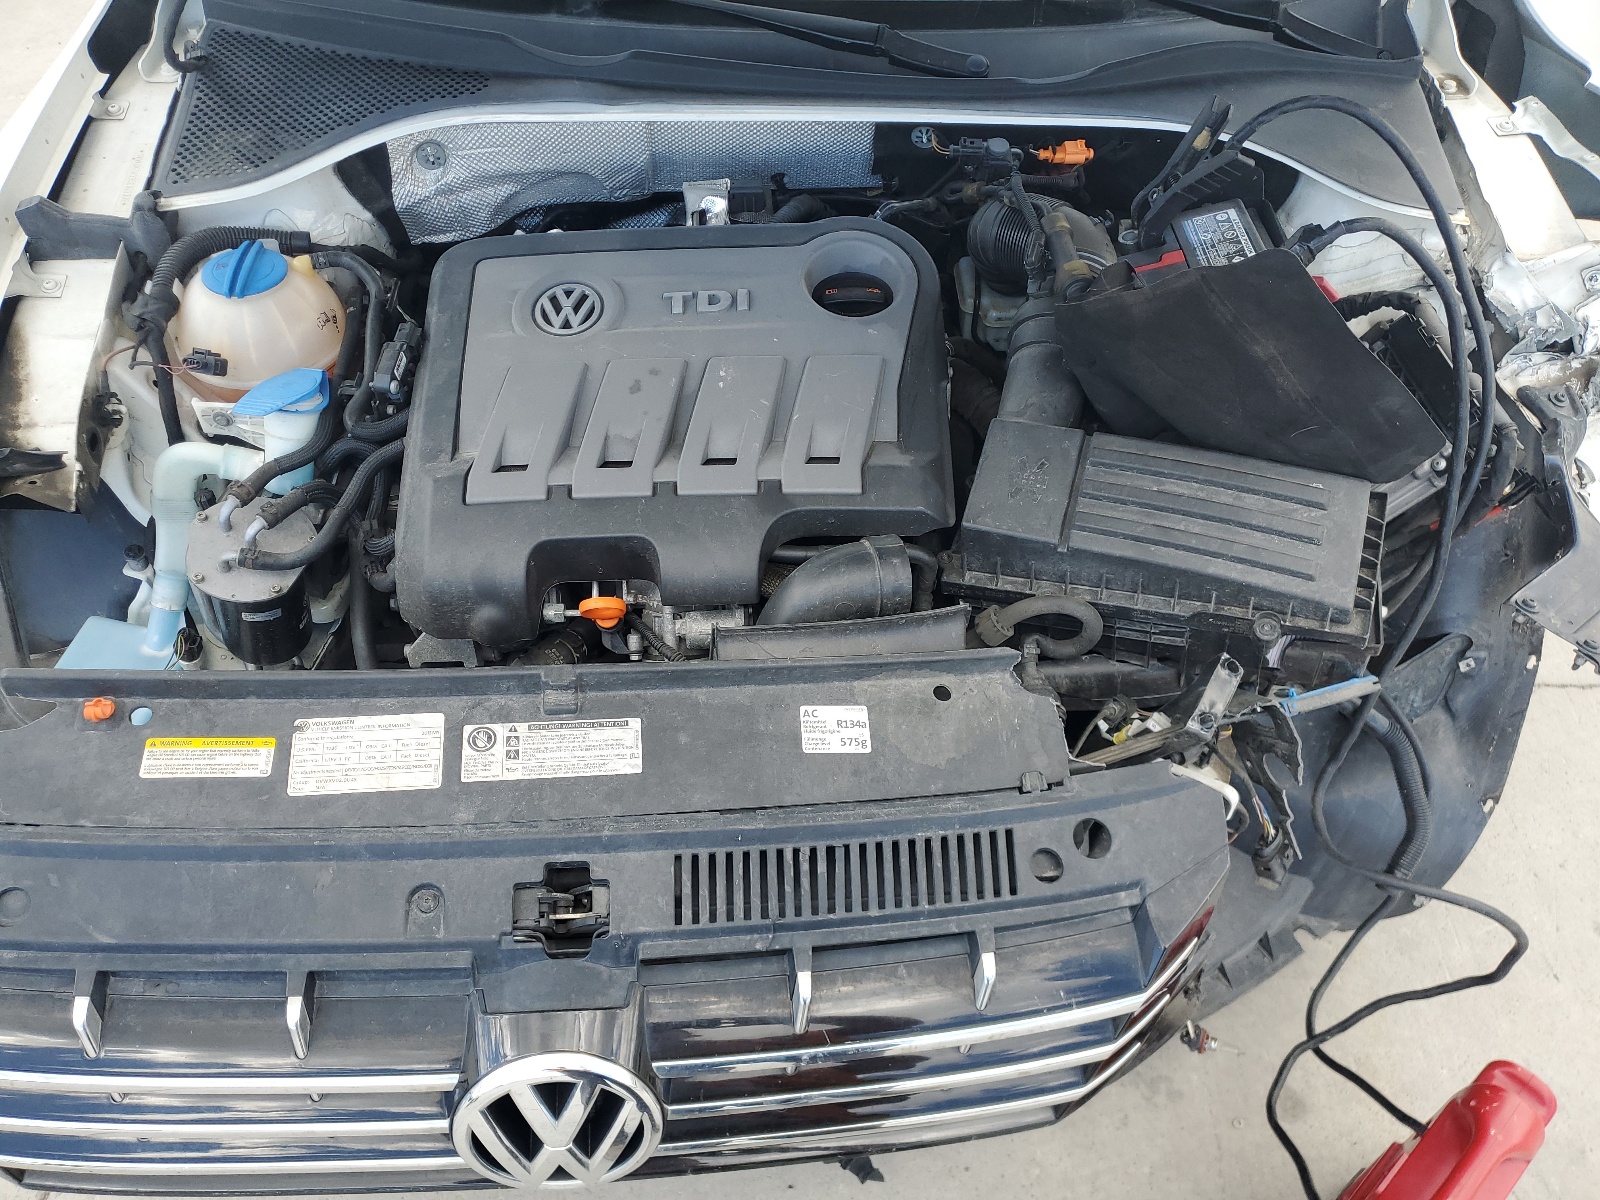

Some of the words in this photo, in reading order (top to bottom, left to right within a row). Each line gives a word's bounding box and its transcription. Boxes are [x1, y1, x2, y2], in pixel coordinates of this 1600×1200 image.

[532, 283, 604, 336] VW
[663, 288, 750, 314] TDI
[803, 710, 818, 718] AC
[837, 720, 867, 728] R134a
[841, 738, 867, 749] 575g
[451, 1050, 662, 1190] VW
